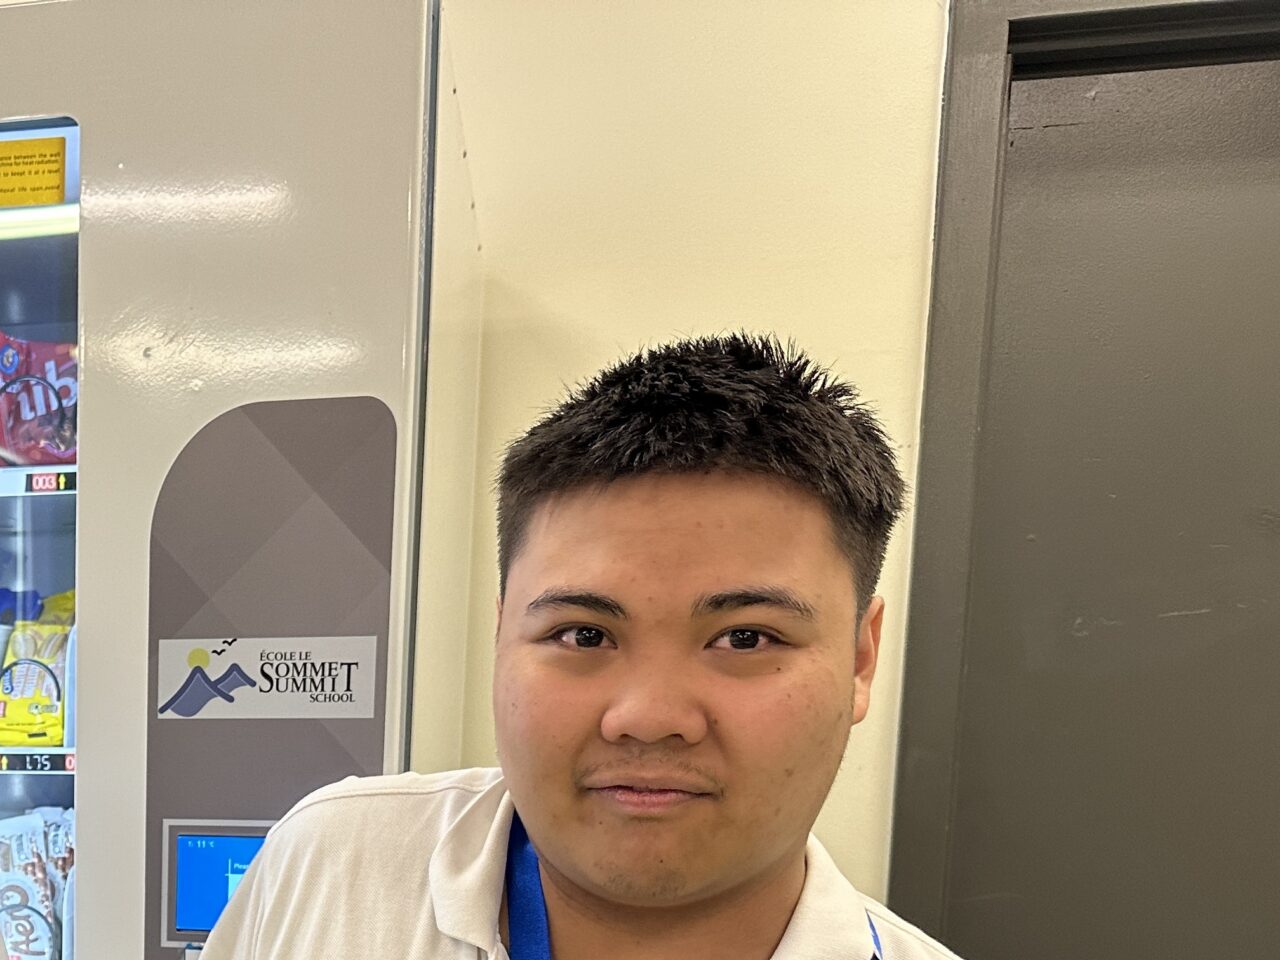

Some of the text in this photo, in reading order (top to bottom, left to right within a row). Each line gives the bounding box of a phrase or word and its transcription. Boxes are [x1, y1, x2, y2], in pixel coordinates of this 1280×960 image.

[32, 476, 57, 489] 003
[259, 649, 312, 662] ÉCOLE LE
[309, 693, 356, 703] SCHOOL
